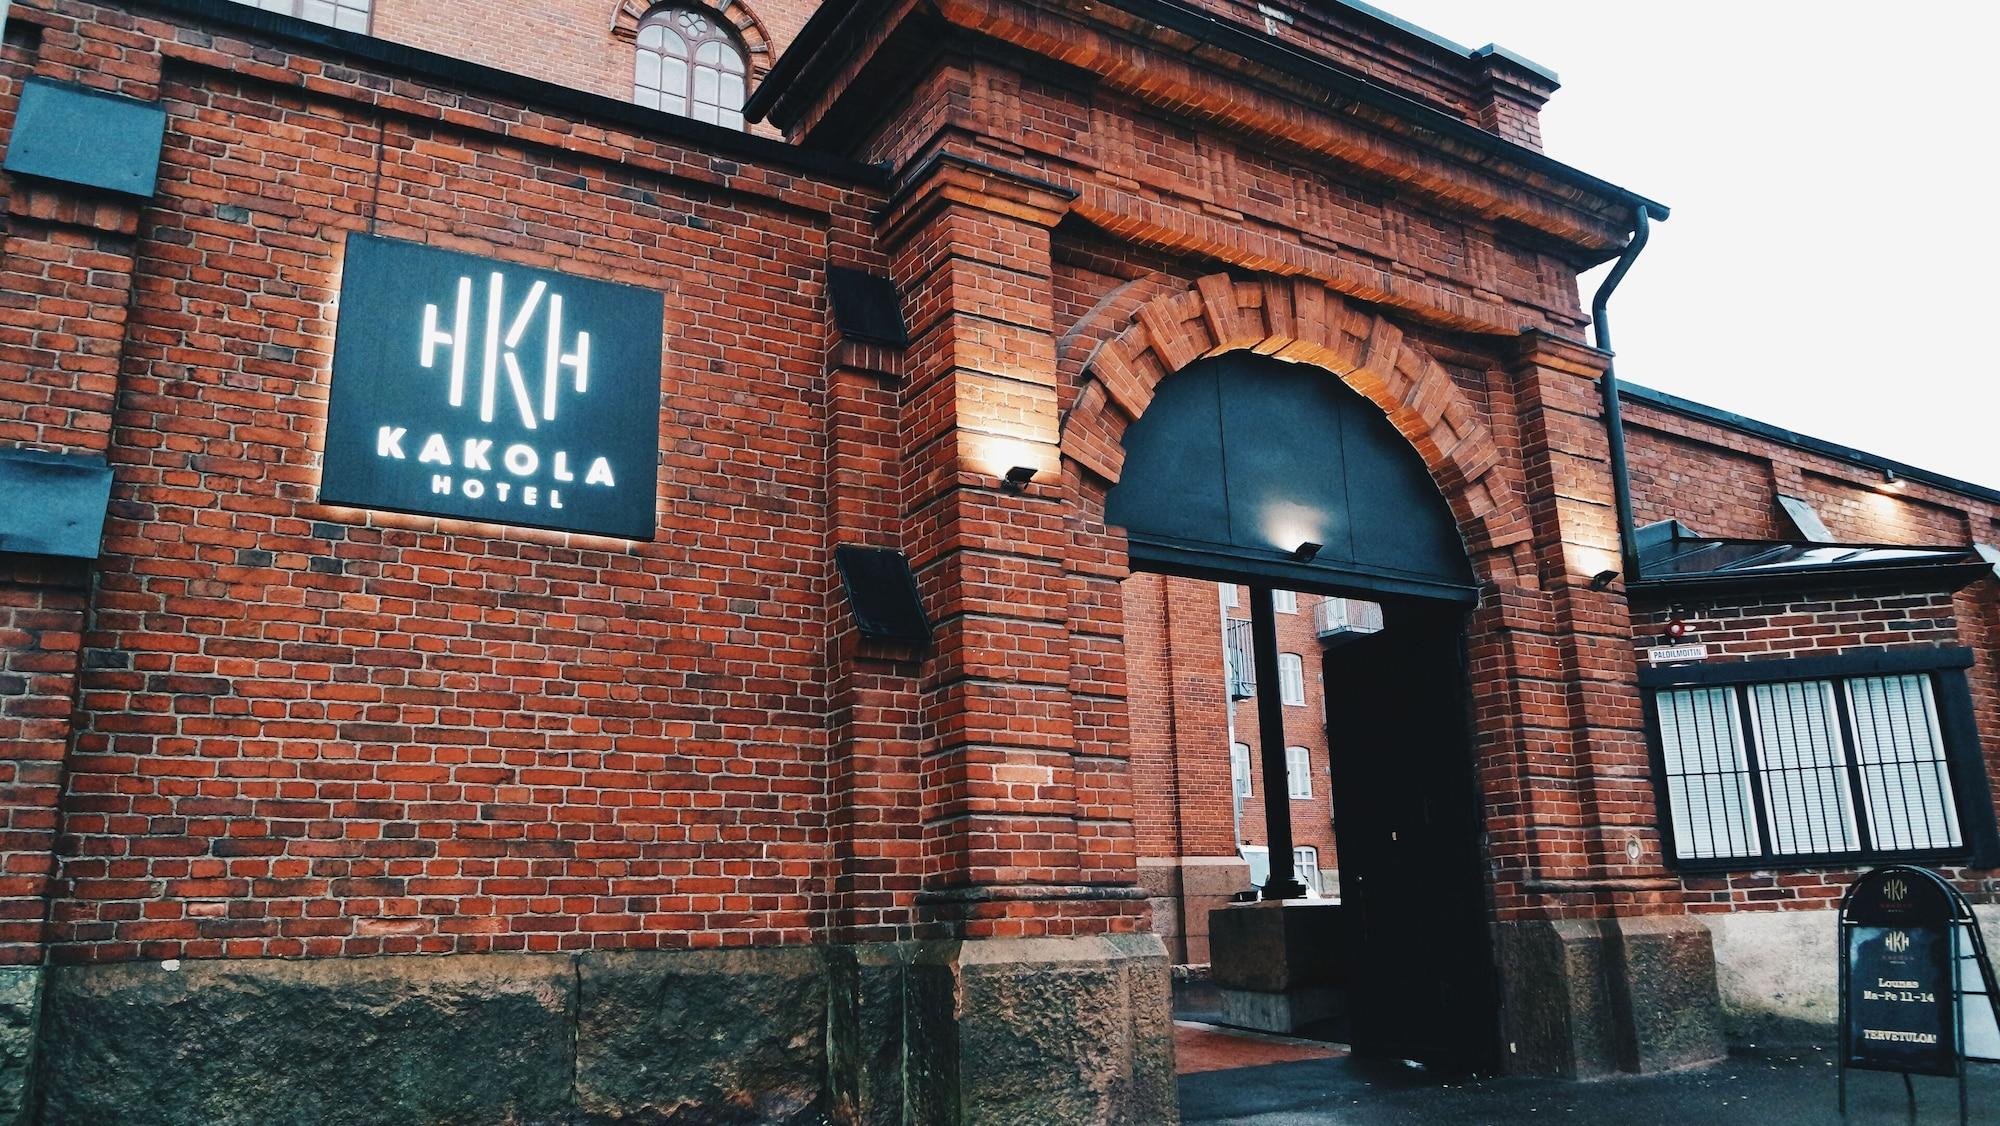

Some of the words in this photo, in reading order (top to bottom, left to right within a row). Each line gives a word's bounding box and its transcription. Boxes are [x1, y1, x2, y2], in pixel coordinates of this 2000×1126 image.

[376, 425, 615, 487] KAKOLA
[431, 474, 563, 509] HOTEL
[1653, 648, 1702, 659] PALOILMOITIN
[1878, 978, 1920, 989] Lounas
[1863, 990, 1898, 1001] Ma-Pe
[1900, 991, 1936, 1003] 11-14
[1863, 1029, 1937, 1044] TERVETULOA!
